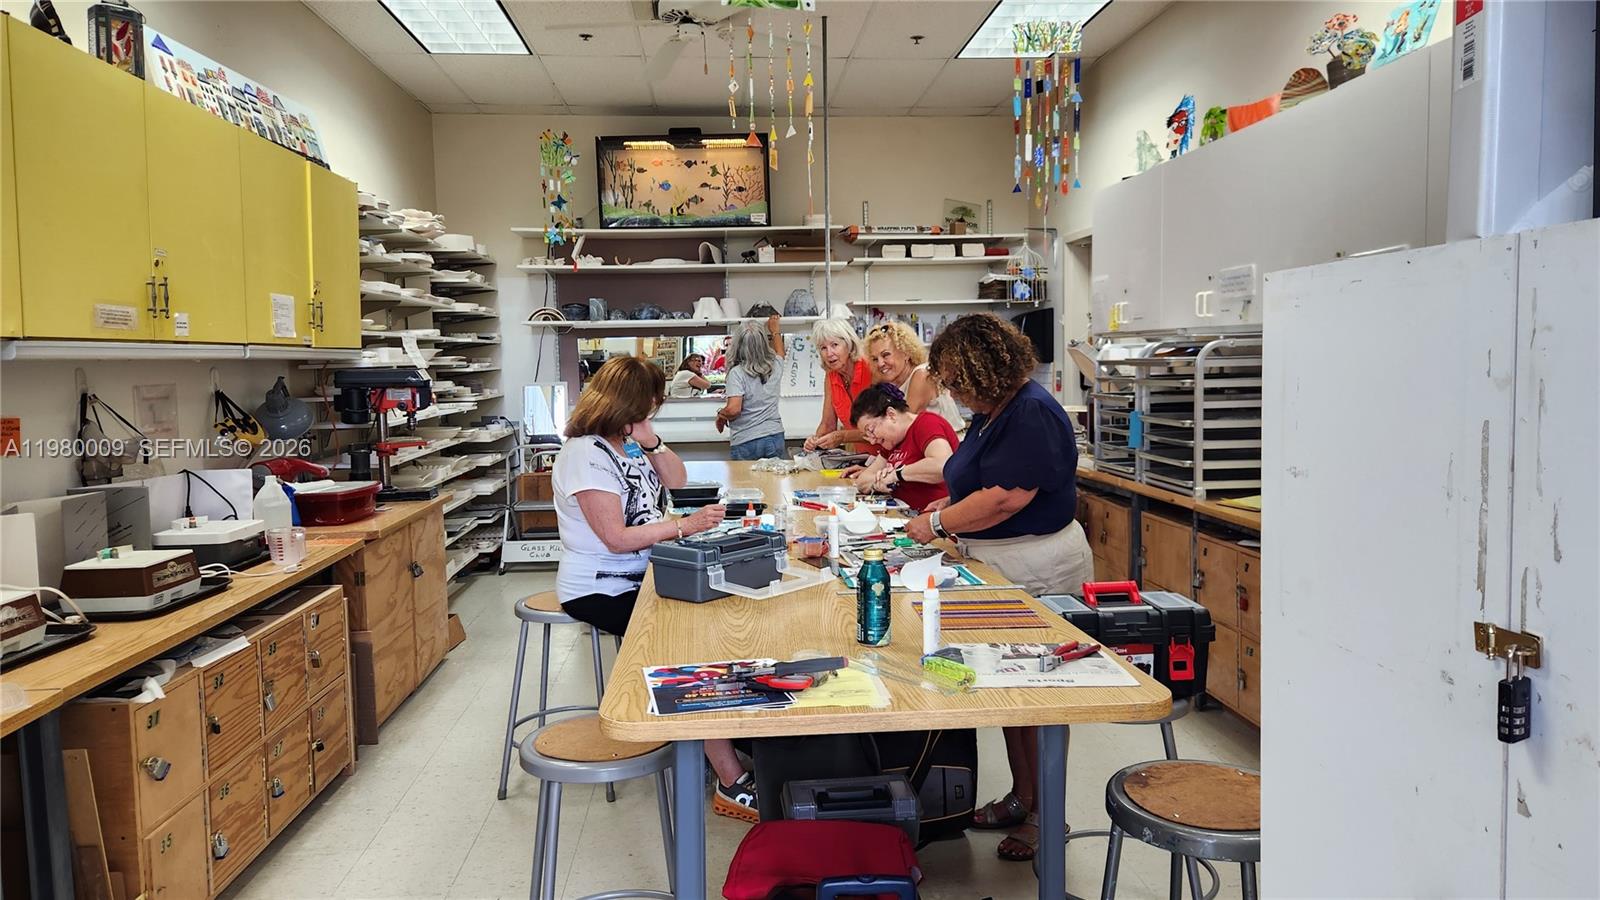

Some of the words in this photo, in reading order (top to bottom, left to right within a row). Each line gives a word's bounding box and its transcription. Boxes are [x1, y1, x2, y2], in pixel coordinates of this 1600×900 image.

[268, 641, 277, 656] 33
[213, 672, 225, 690] 32
[146, 709, 160, 730] 31
[274, 740, 284, 757] 37
[220, 782, 230, 801] 36
[161, 832, 172, 854] 35
